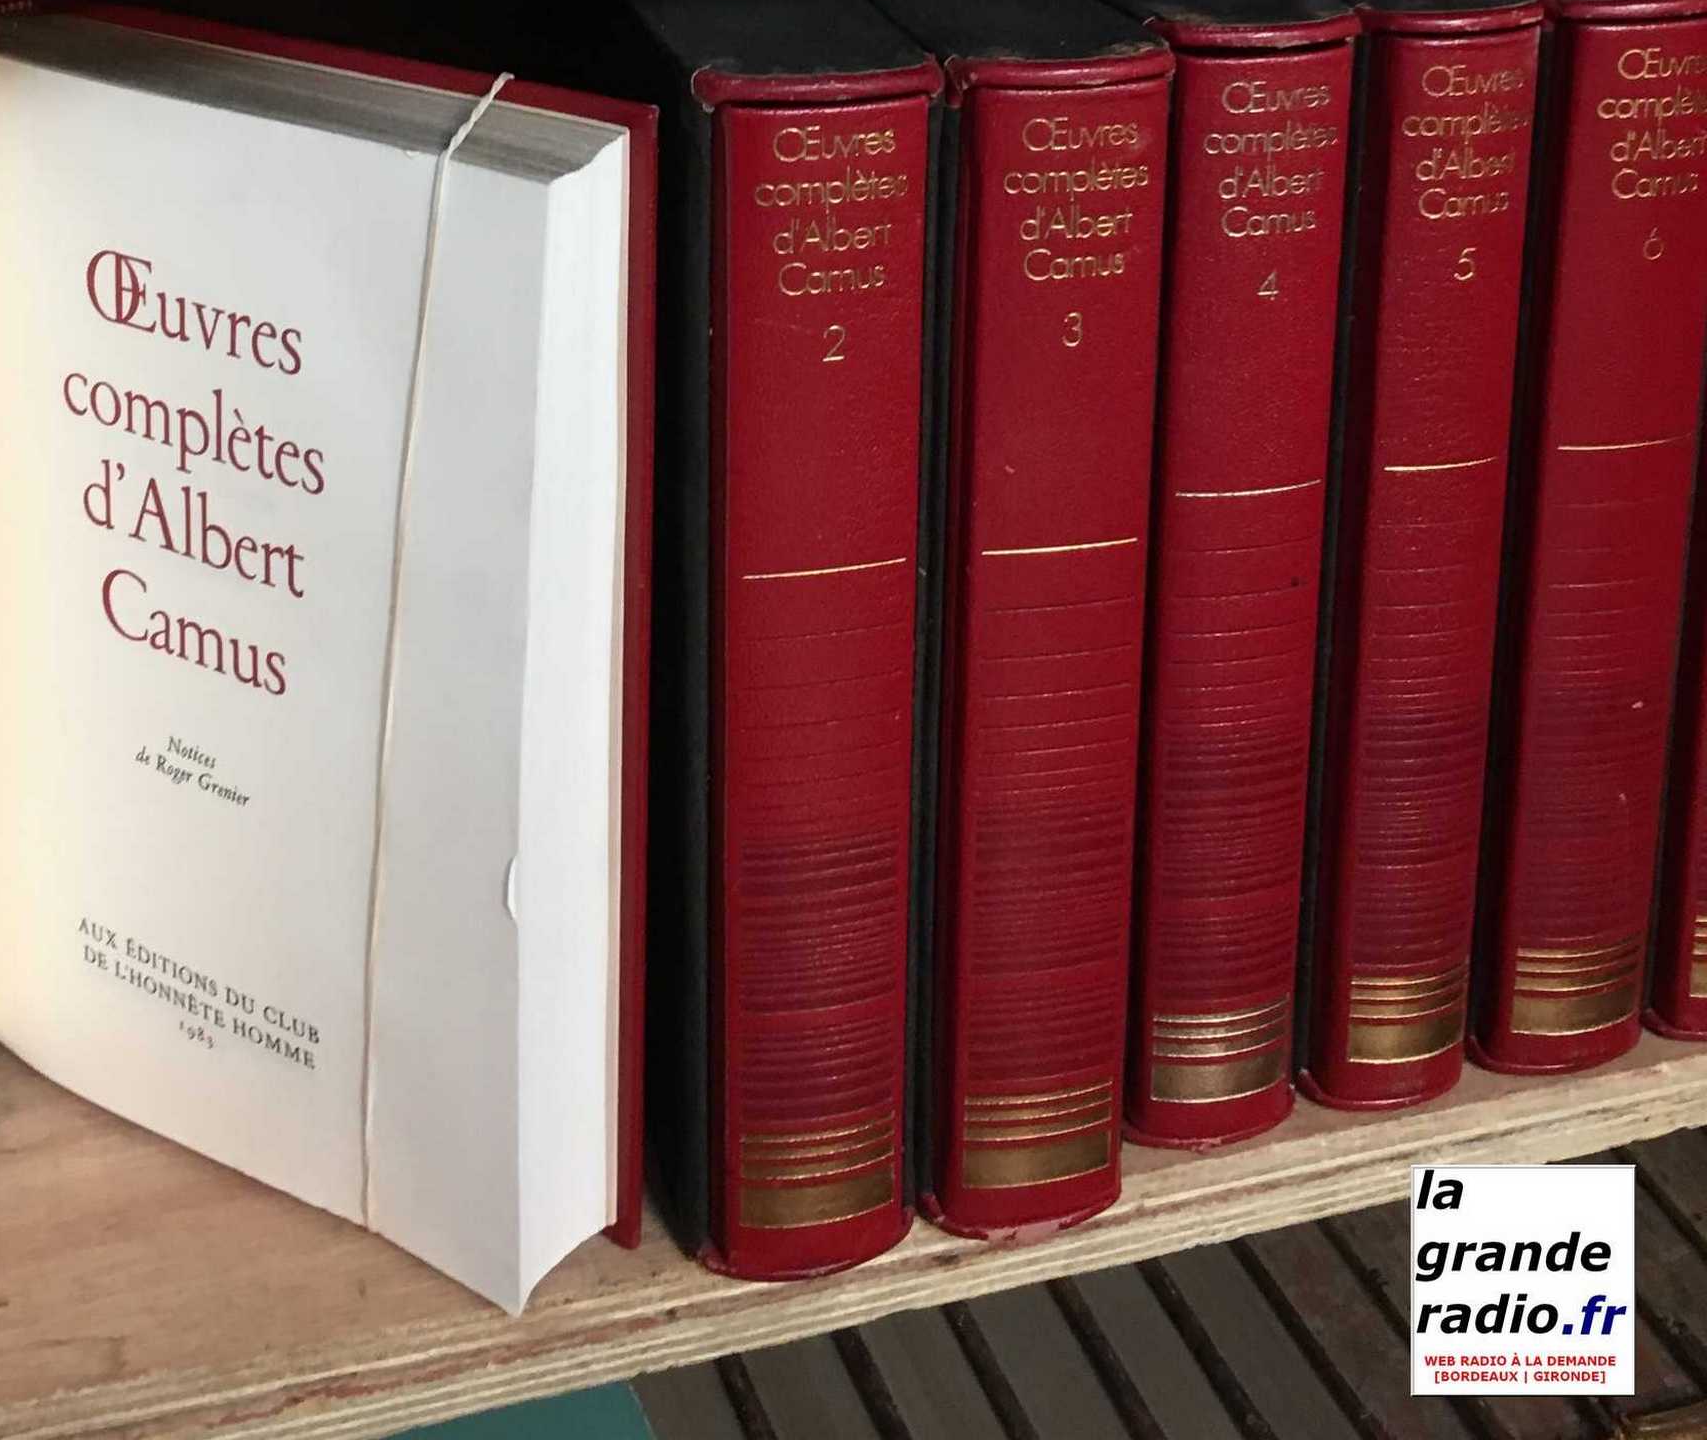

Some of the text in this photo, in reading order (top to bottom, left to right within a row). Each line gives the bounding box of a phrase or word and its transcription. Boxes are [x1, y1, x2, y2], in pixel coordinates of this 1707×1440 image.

[1221, 80, 1332, 115] Œuvres
[773, 126, 896, 162] Œuvres
[1022, 117, 1139, 152] Œuvres
[1204, 121, 1338, 163] complètes
[754, 166, 908, 216] complètes
[1003, 162, 1149, 201] complètes
[1219, 167, 1324, 200] d'Albert
[1611, 169, 1698, 200] Camus
[1221, 206, 1316, 238] Camus
[1418, 189, 1510, 220] Camus
[773, 220, 892, 255] d'Albert
[1020, 206, 1134, 241] d'Albert
[1642, 228, 1665, 260] 6
[778, 261, 885, 296] Camus
[1024, 248, 1125, 281] Camus
[1453, 247, 1476, 281] 5
[1256, 272, 1279, 301] 4
[86, 249, 303, 375] Œuvres
[823, 325, 846, 362] 2
[1062, 312, 1084, 348] 3
[63, 372, 325, 495] complètes
[83, 459, 305, 598] d'Albert
[101, 568, 286, 696] Camus
[167, 736, 217, 769] Notices
[136, 745, 250, 807] de Roger Grenier
[78, 916, 320, 1044] AUX ÉDITIONS DU CLUB
[83, 944, 316, 1070] DE L'HONNÊTE HOMME
